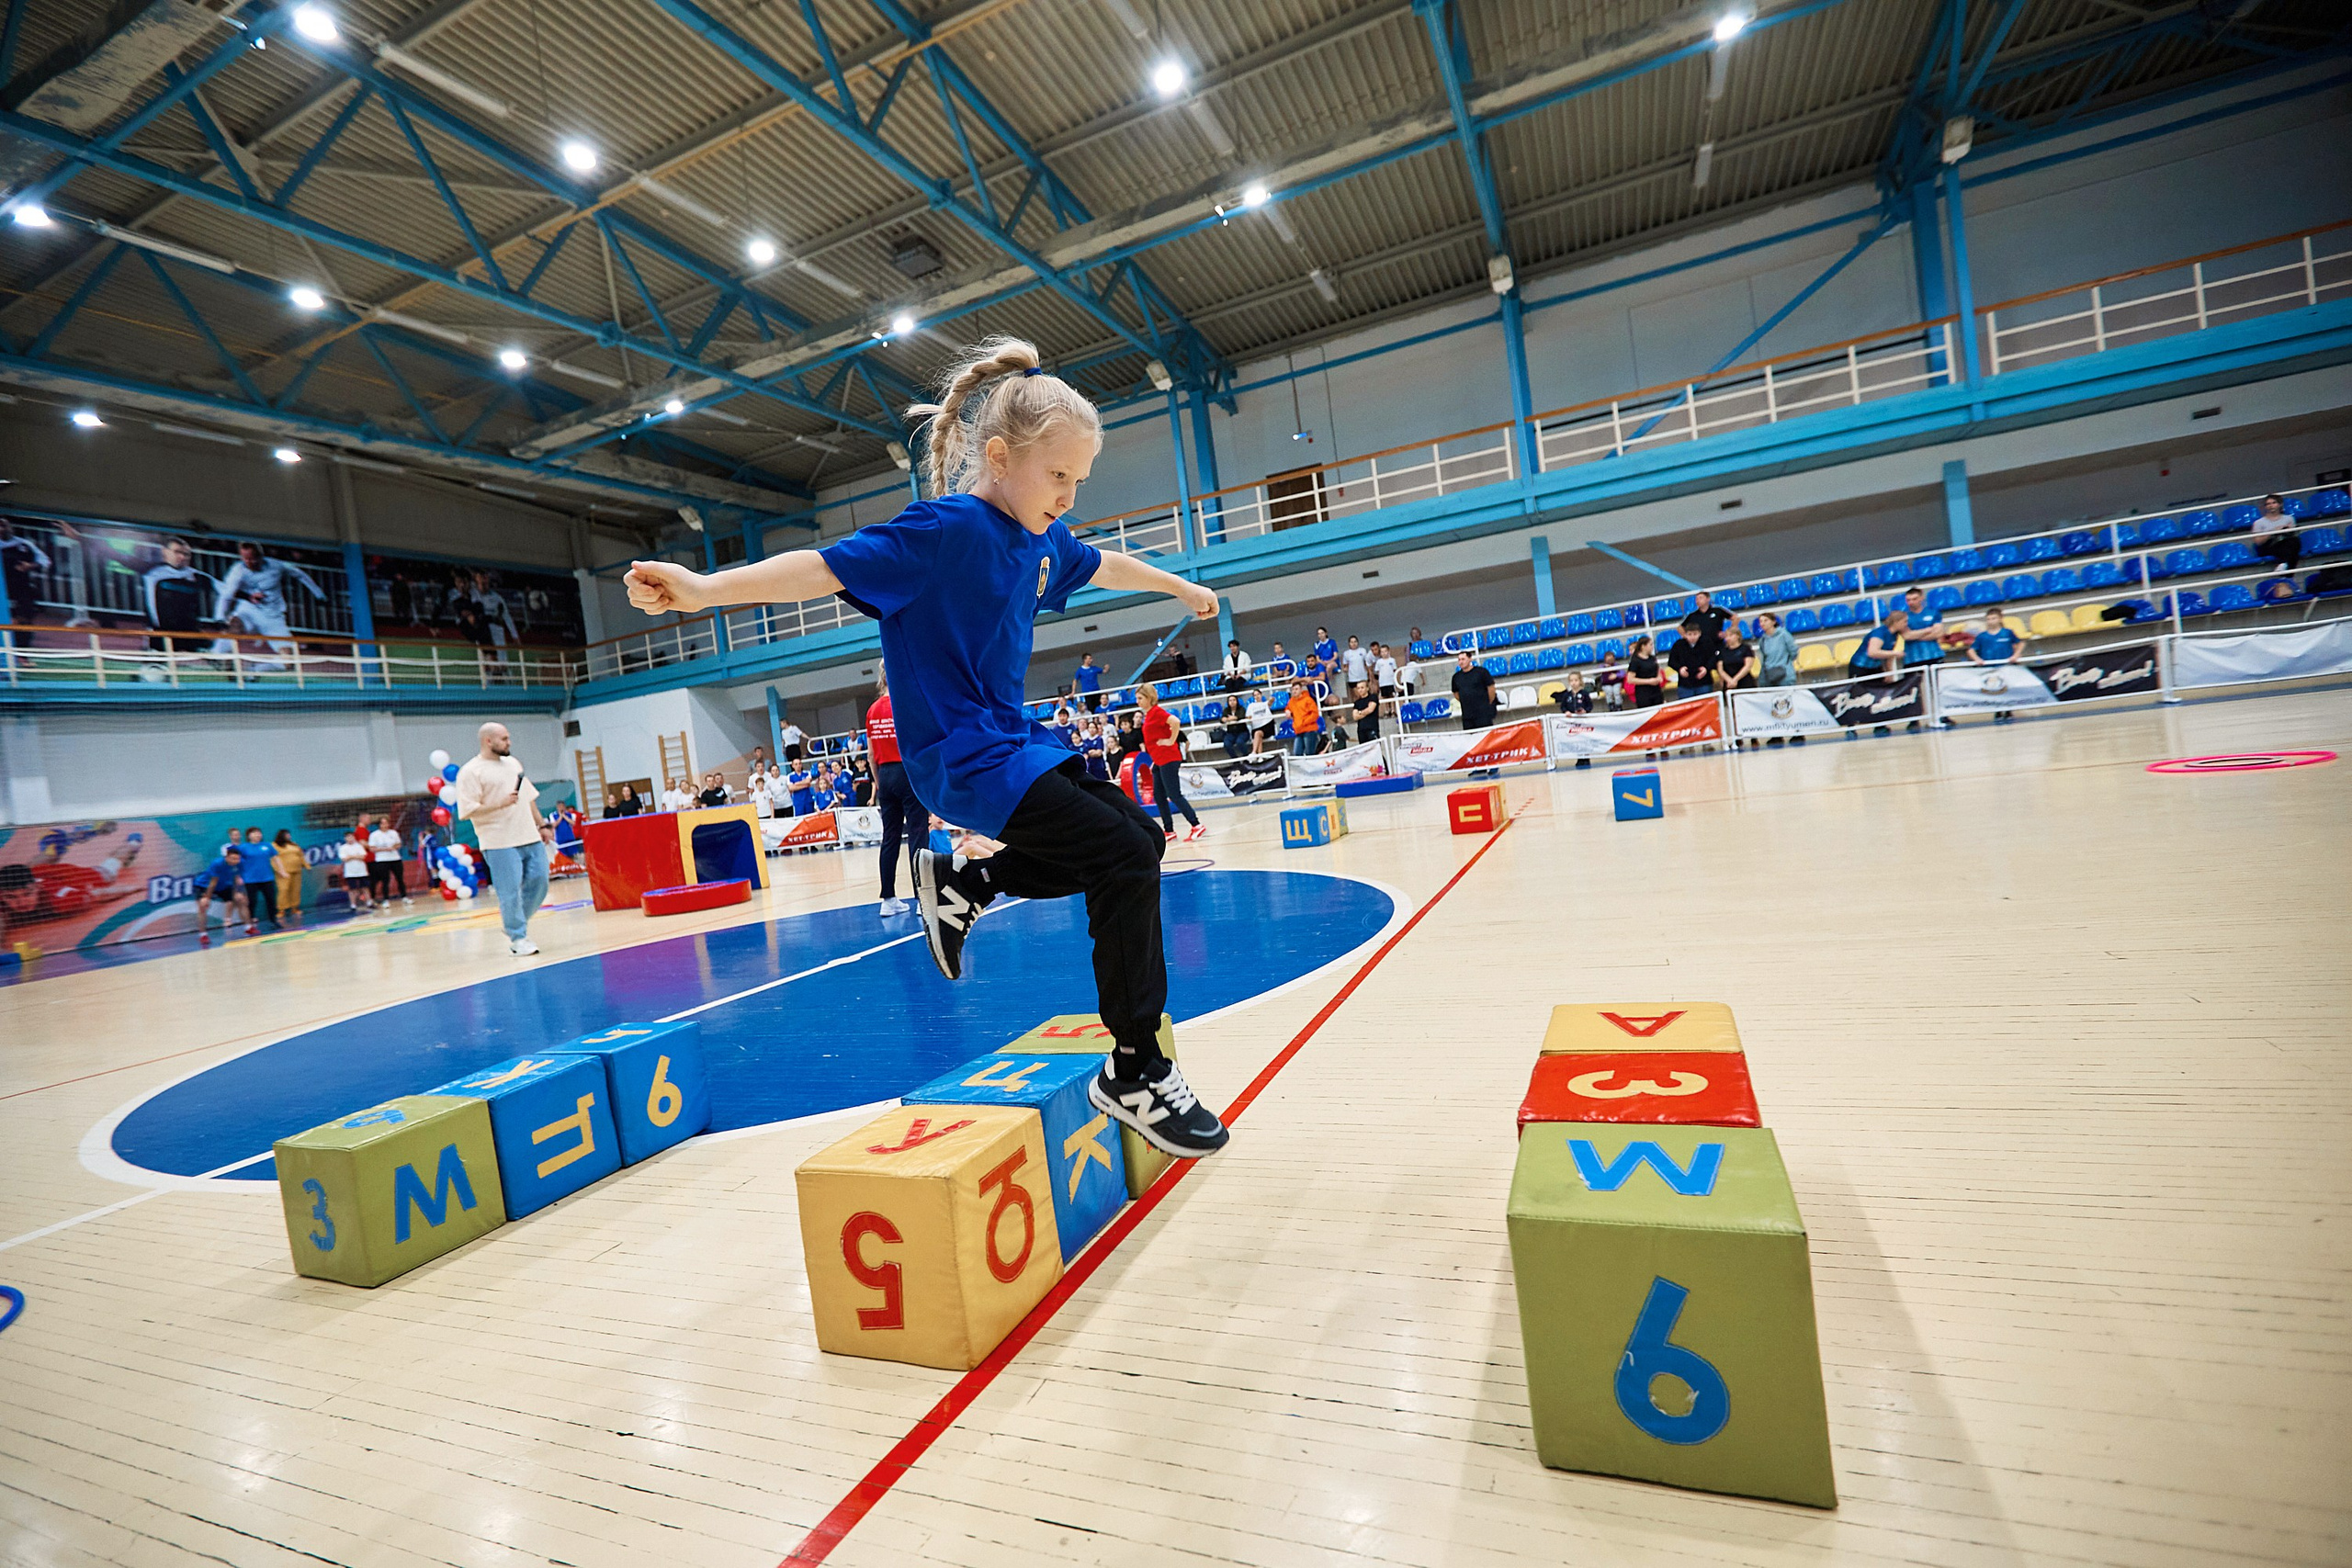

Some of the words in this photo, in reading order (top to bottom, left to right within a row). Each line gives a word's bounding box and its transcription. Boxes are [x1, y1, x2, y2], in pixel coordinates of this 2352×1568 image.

[1465, 747, 1528, 764] ХЕТ-ТРИК
[1285, 818, 1312, 842] Щ
[1597, 1010, 1688, 1038] А
[647, 1055, 683, 1127] 6
[395, 1143, 477, 1245] М
[1613, 1275, 1731, 1446] 6
